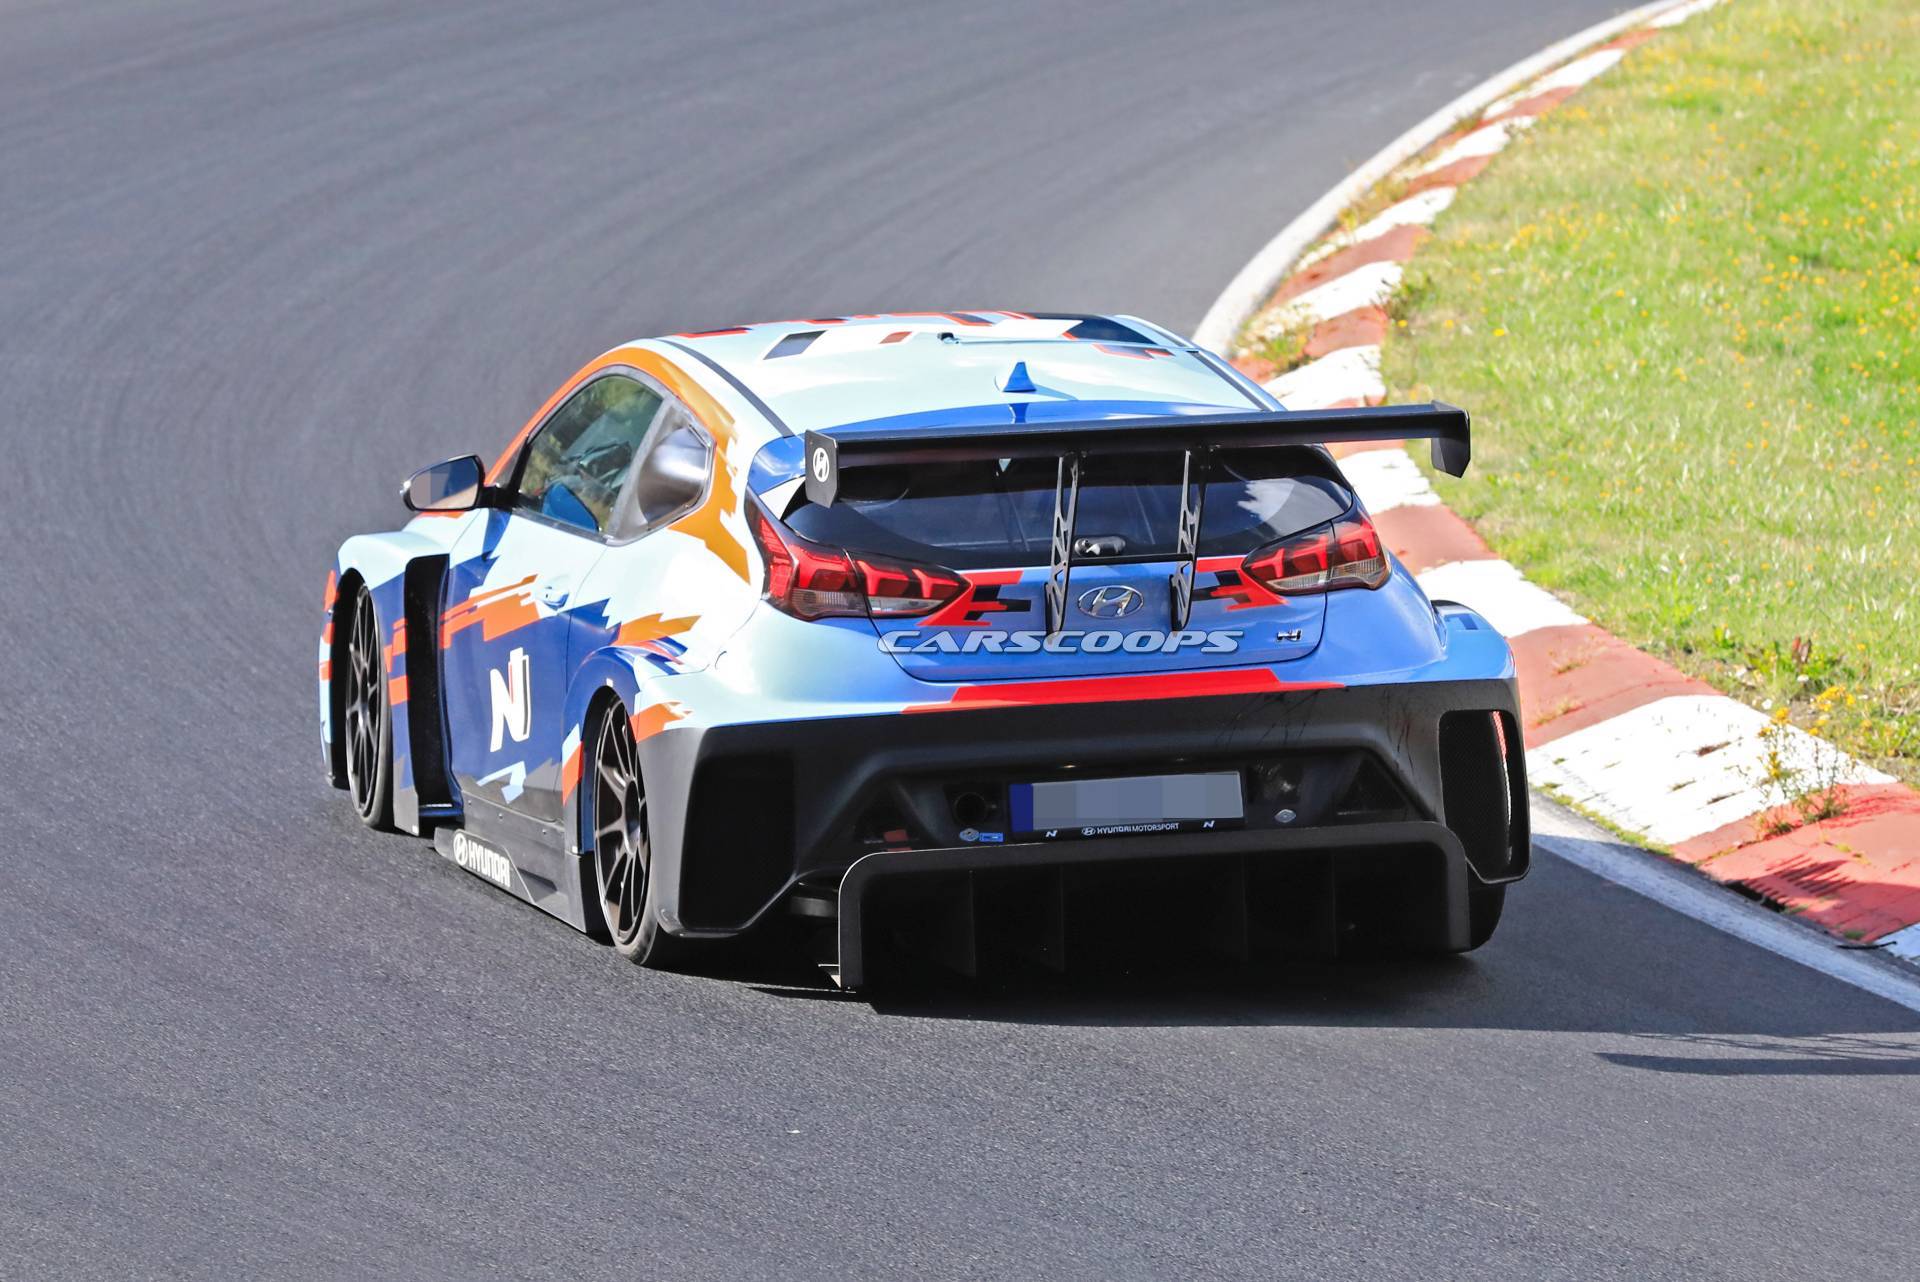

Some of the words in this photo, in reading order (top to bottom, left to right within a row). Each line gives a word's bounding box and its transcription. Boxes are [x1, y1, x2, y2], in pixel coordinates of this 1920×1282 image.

[489, 646, 531, 753] N
[1097, 825, 1131, 834] HYUNDAI
[1132, 822, 1180, 832] MOTORSPORT
[468, 839, 511, 888] HYUNDAI
